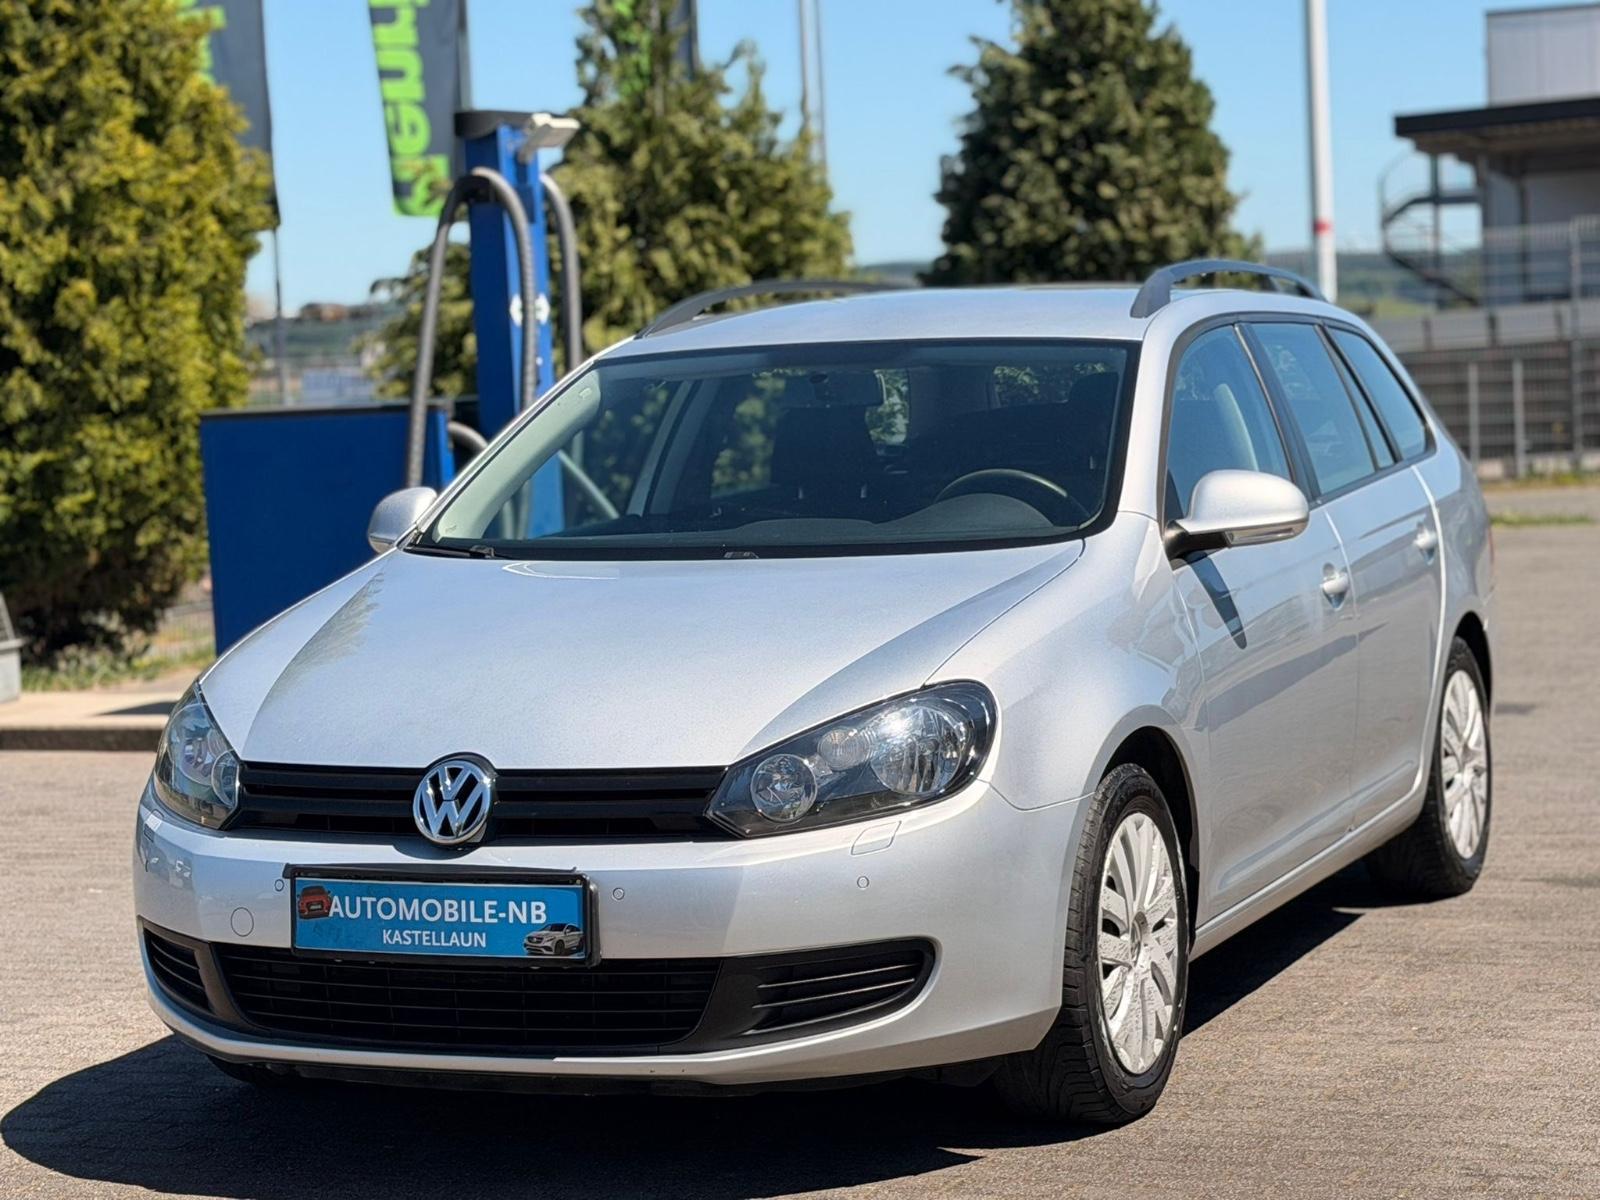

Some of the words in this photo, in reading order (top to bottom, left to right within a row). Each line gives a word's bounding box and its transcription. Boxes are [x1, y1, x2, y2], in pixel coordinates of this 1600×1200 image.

[414, 761, 489, 842] VW
[328, 894, 548, 924] AUTOMOBILE-NB
[382, 929, 487, 948] KASTELLAUN
